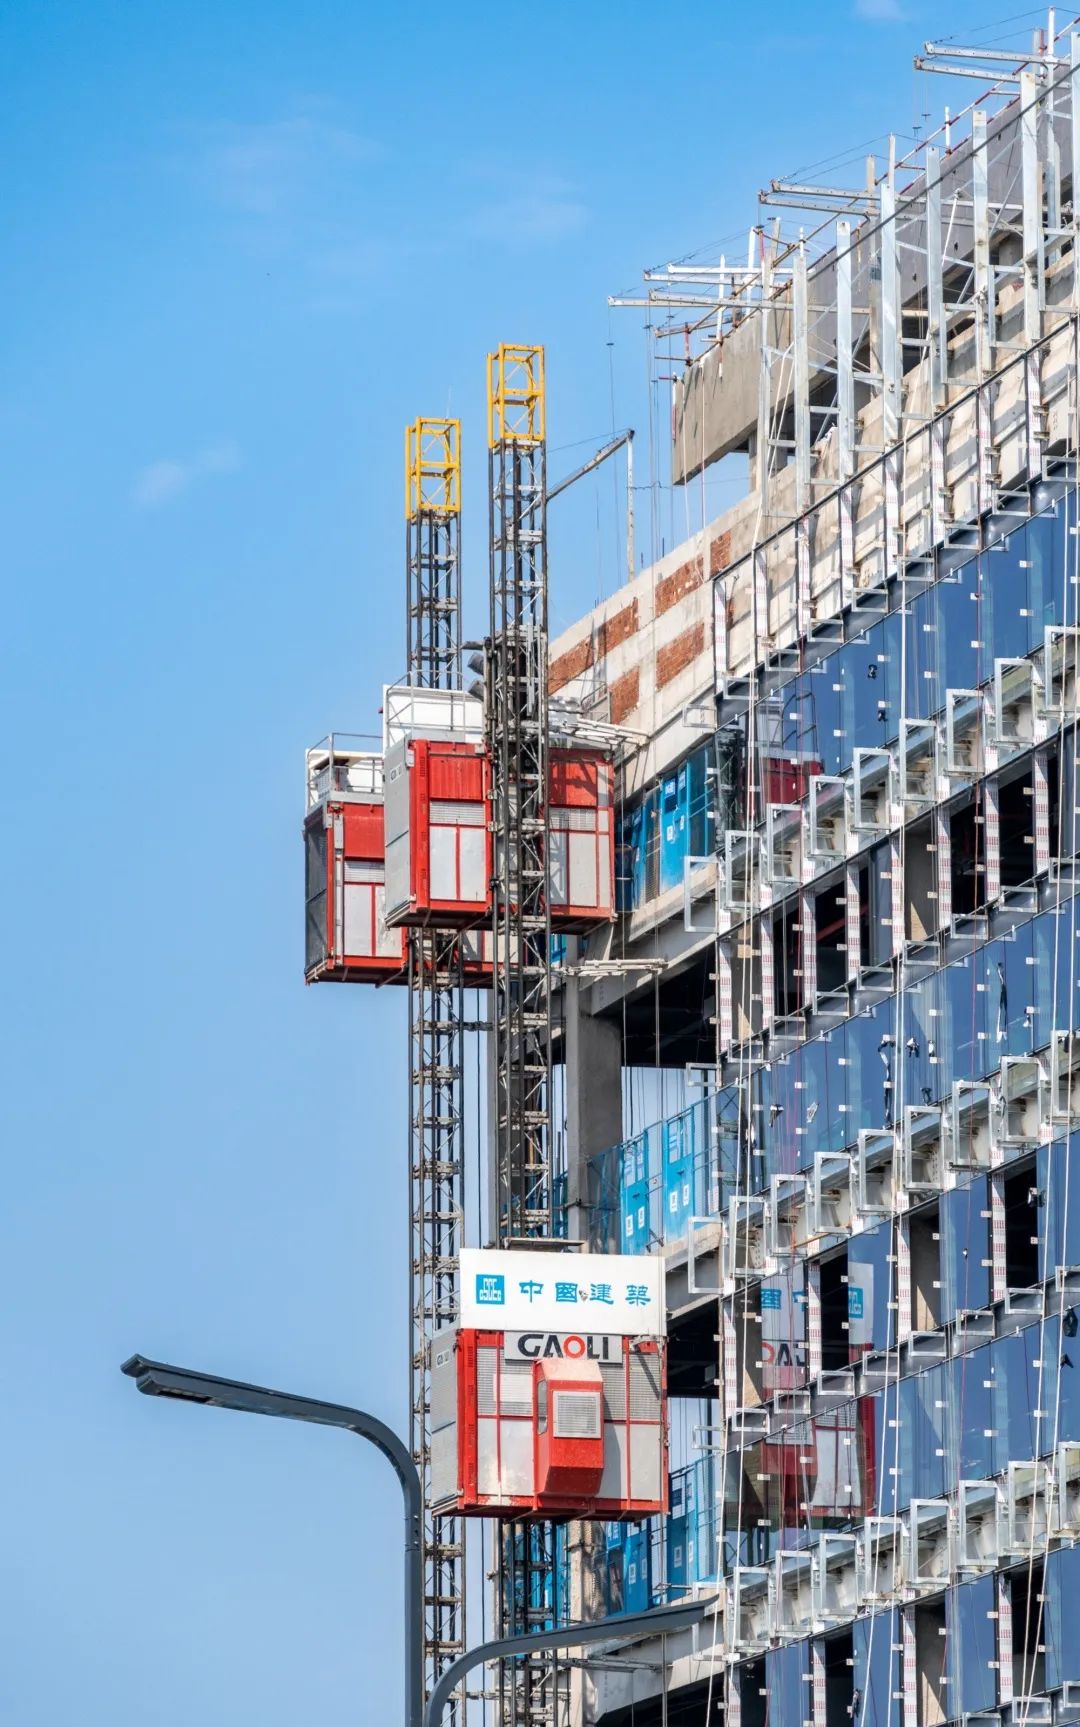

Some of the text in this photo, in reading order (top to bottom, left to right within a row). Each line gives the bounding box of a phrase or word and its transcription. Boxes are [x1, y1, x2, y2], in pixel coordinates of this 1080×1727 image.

[518, 1279, 651, 1306] 中國建築
[517, 1333, 609, 1360] GAOLI
